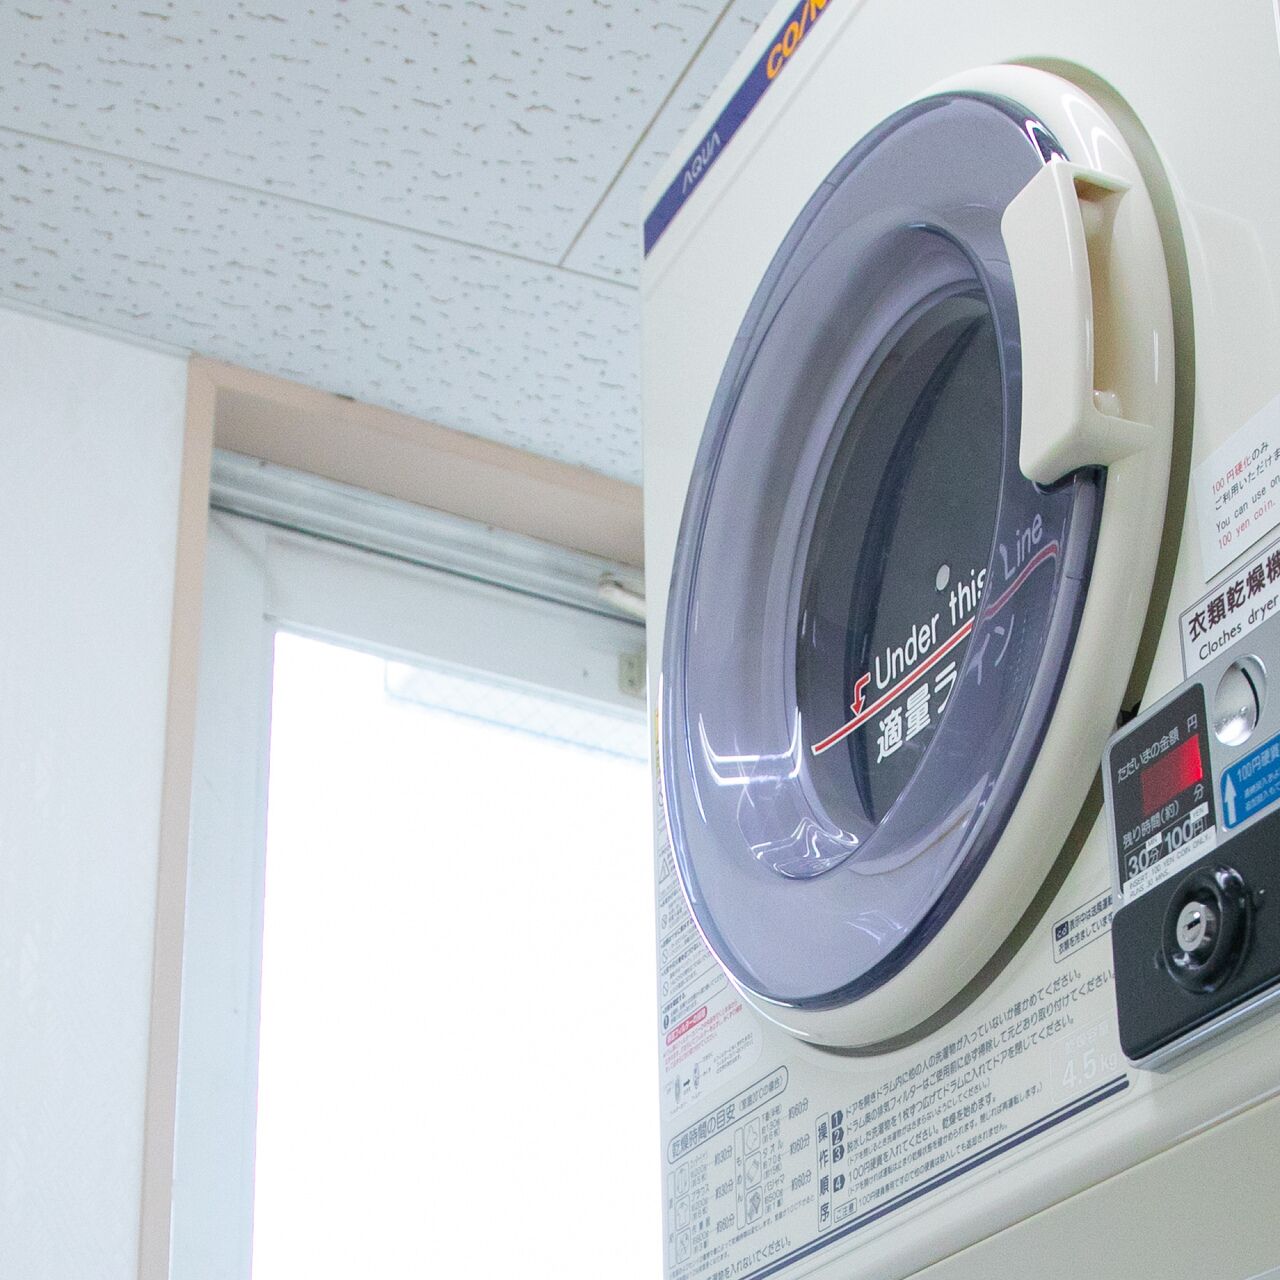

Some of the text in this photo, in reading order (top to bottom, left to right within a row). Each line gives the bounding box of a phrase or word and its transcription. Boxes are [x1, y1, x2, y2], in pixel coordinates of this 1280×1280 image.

[682, 132, 721, 194] AQUA
[1216, 517, 1231, 533] You
[1234, 503, 1249, 520] can
[1251, 487, 1267, 505] use
[1219, 532, 1233, 550] 100
[1235, 519, 1251, 538] yen
[875, 513, 1043, 690] Under this Line
[1199, 593, 1280, 661] Clothes dryer
[1118, 713, 1198, 784] ただいまの金額 円
[1193, 783, 1204, 802] 分
[1177, 847, 1191, 860] COIN
[671, 1103, 735, 1158] 乾燥時間の目安
[817, 1121, 830, 1223] 操作順序
